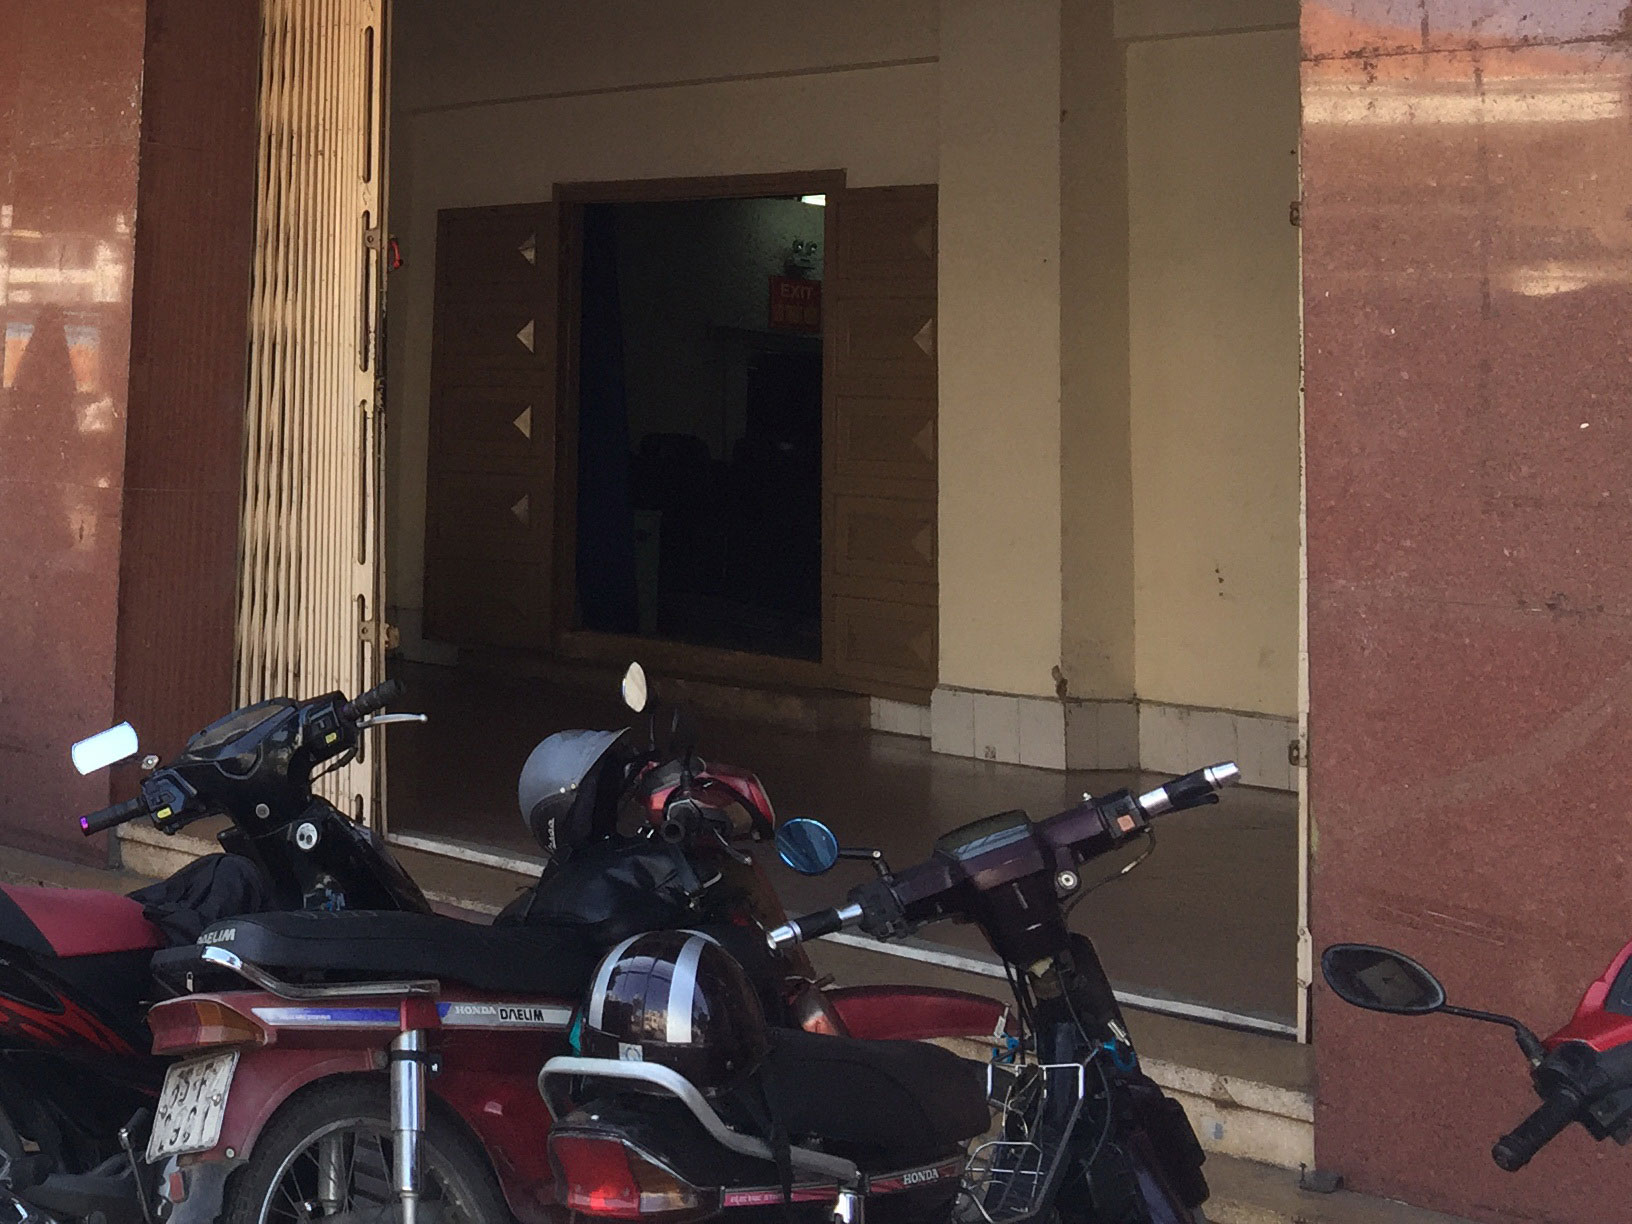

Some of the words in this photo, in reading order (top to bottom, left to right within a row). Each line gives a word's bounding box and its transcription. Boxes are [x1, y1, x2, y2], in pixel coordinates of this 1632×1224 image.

[454, 1004, 497, 1016] HONDA
[499, 1007, 546, 1022] DAELIM
[902, 1167, 940, 1186] HONDA
